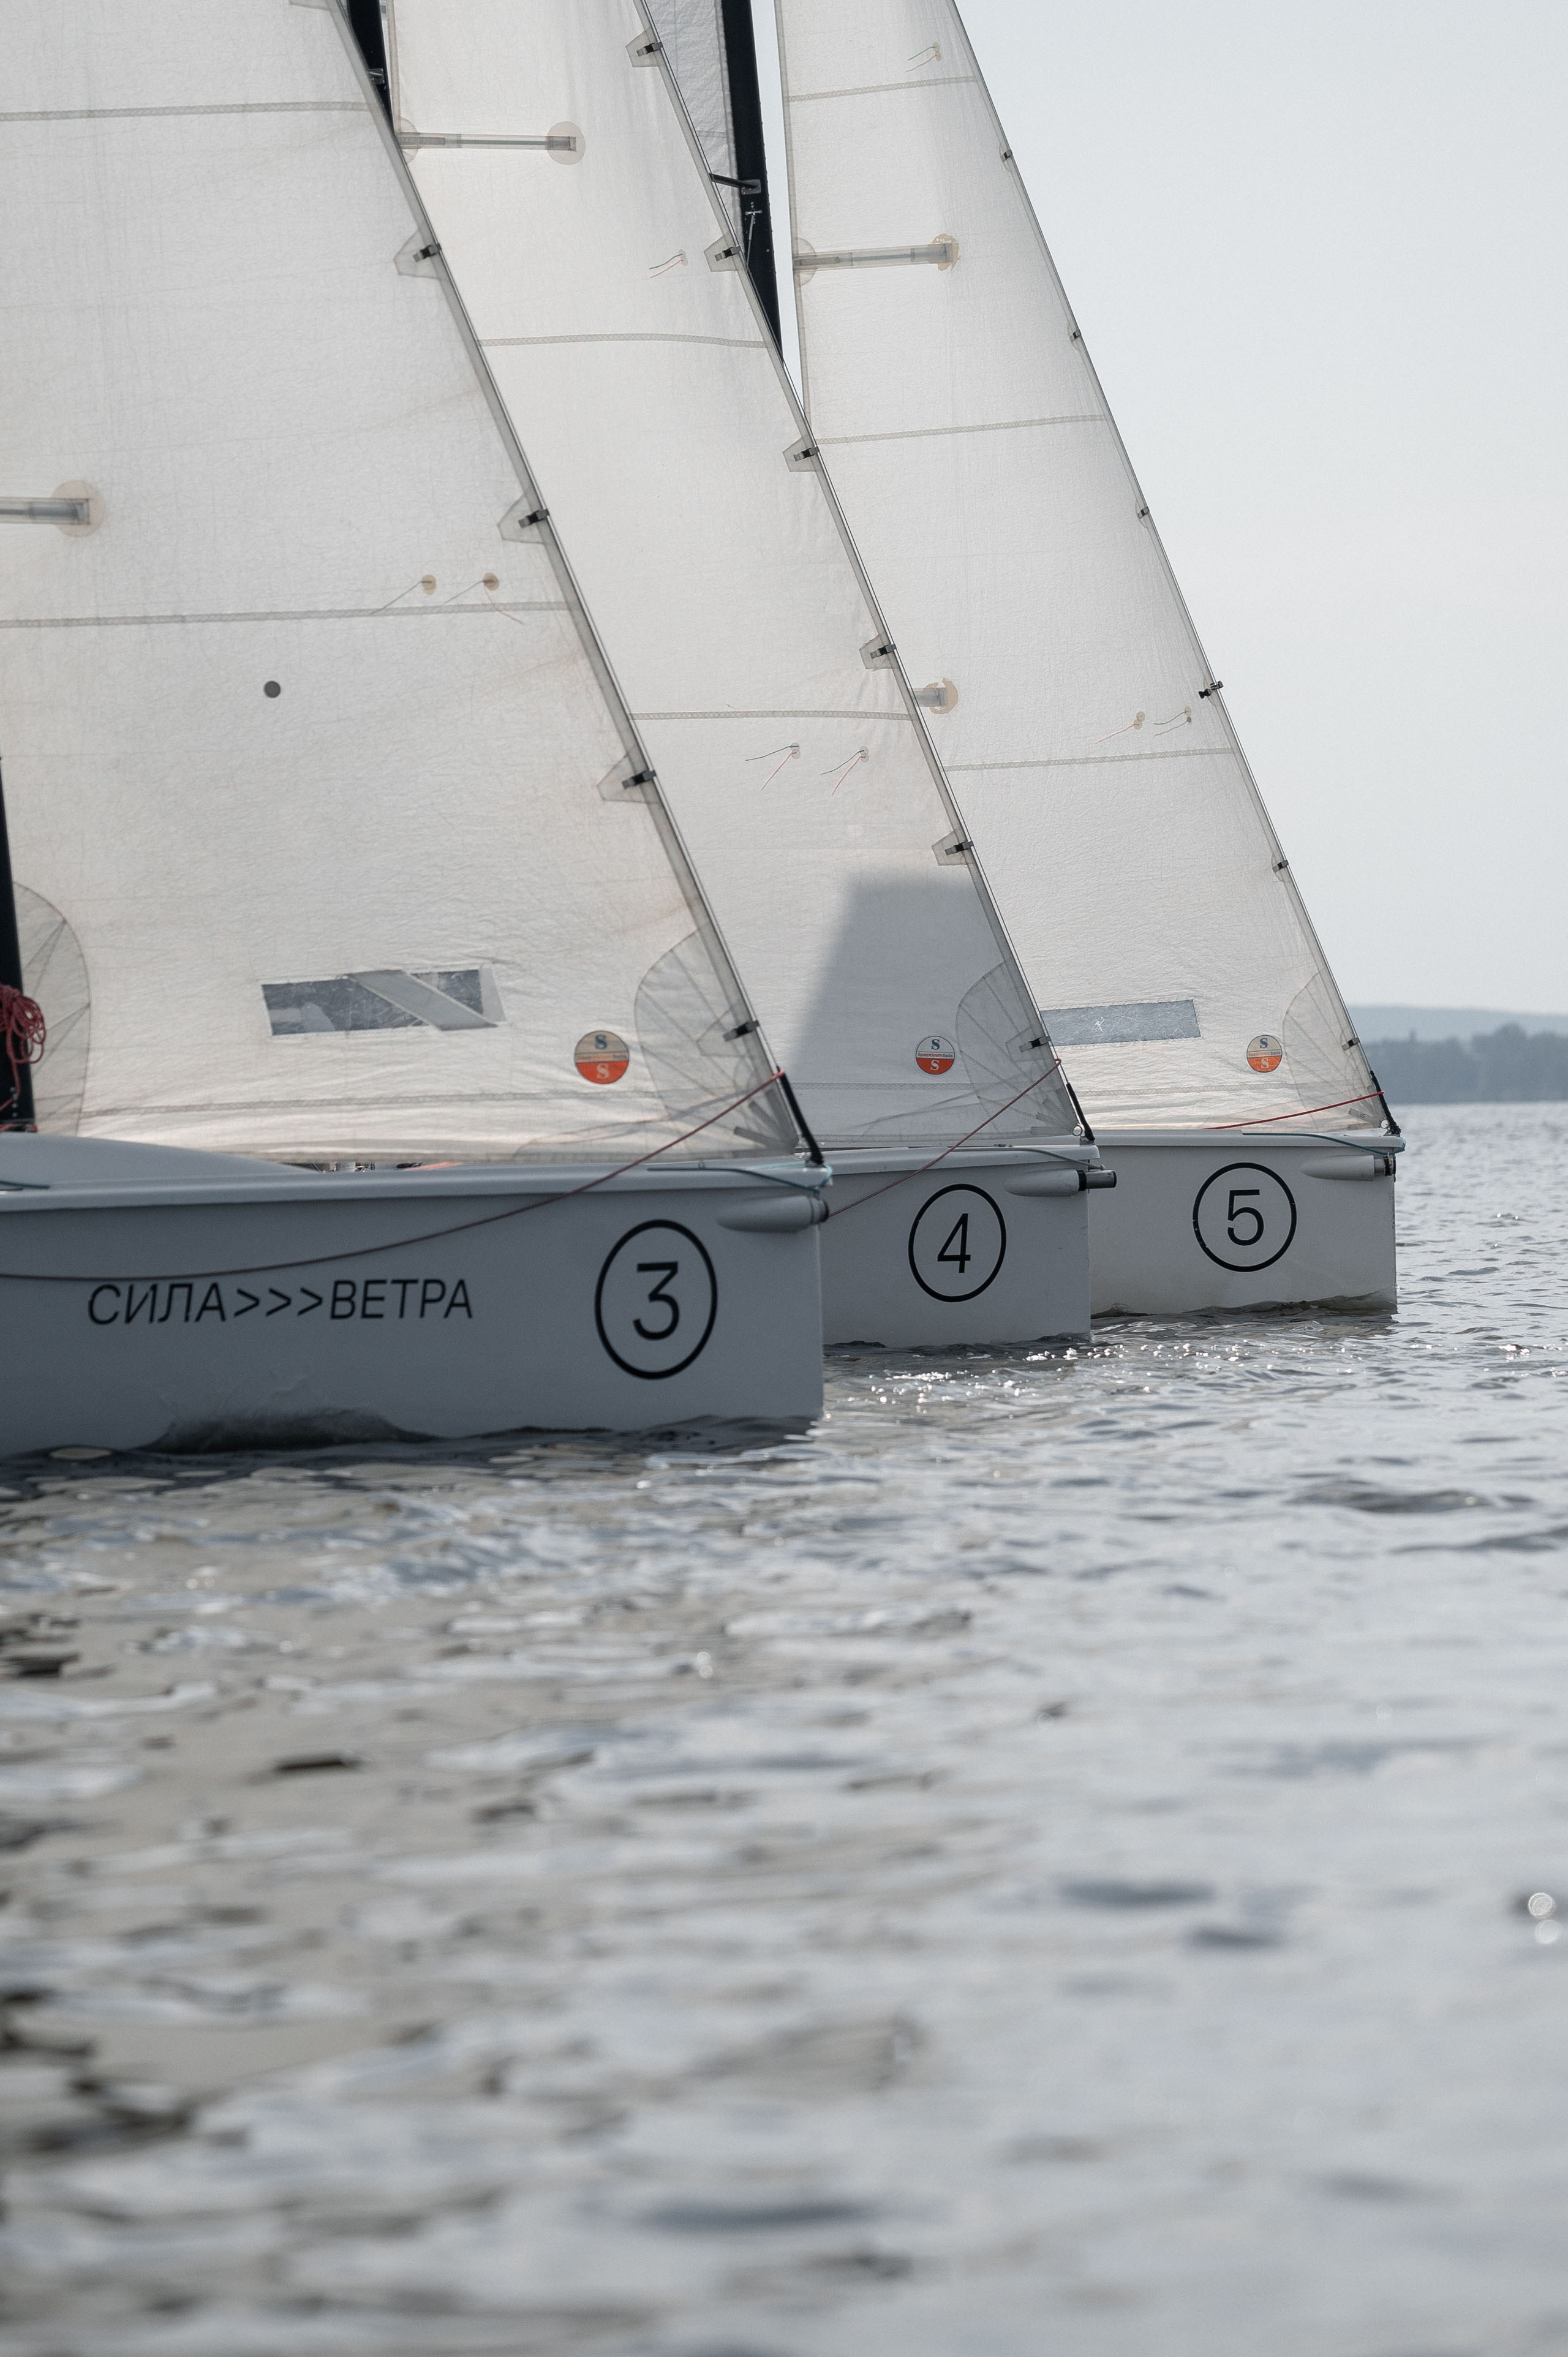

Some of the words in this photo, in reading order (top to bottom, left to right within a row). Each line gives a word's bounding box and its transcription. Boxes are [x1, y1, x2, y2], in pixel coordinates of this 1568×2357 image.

[931, 1038, 940, 1050] S
[1260, 1038, 1268, 1049] S
[930, 1059, 940, 1071] S
[1261, 1057, 1270, 1069] S
[1227, 1189, 1264, 1246] 5
[937, 1213, 971, 1273] 4
[633, 1261, 680, 1340] 3
